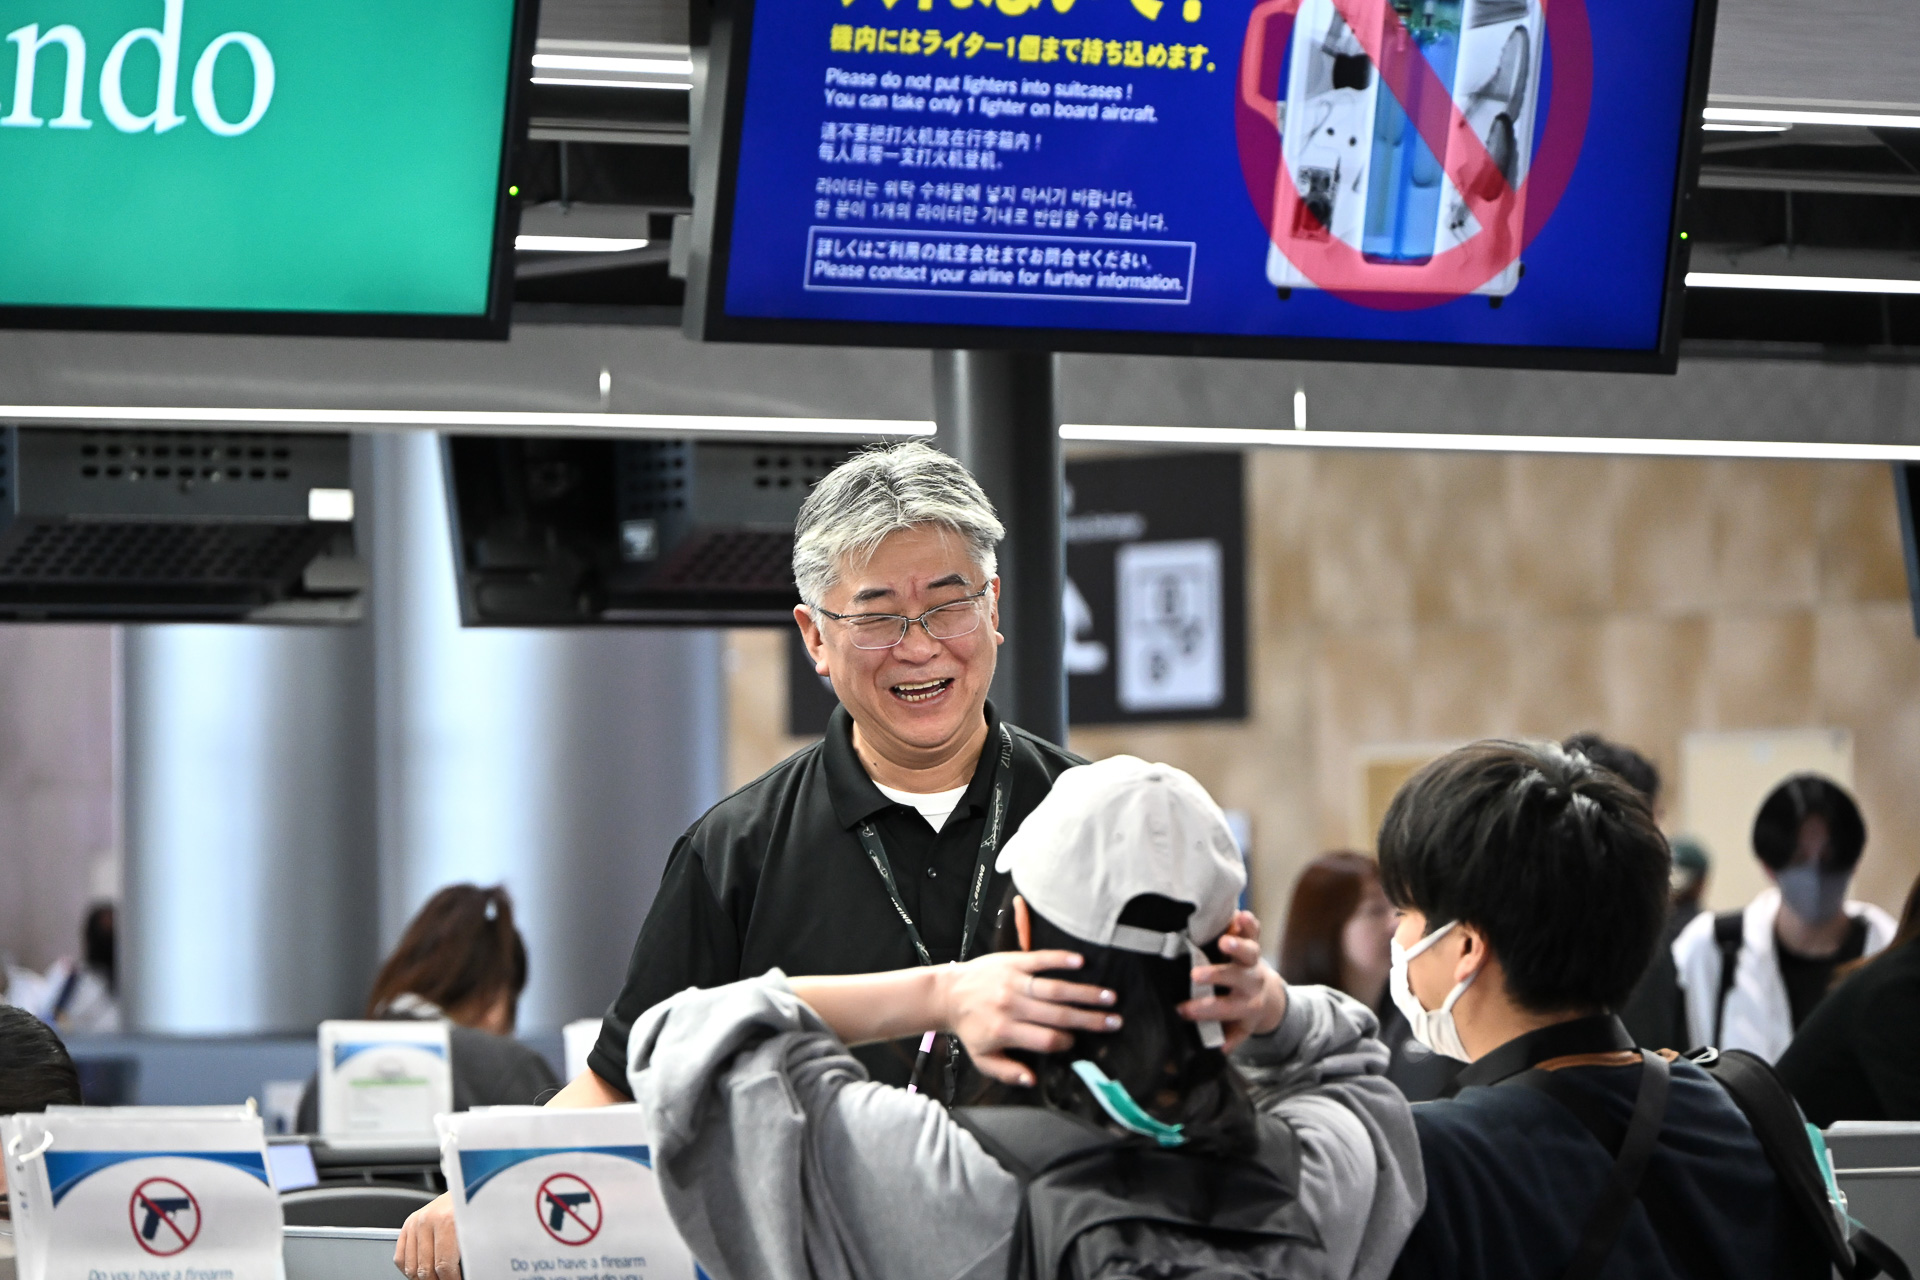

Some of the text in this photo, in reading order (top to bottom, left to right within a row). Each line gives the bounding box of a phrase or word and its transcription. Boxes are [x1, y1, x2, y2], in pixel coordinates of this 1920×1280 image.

[0, 0, 275, 136] ndo
[825, 67, 877, 87] Please
[880, 70, 902, 89] do
[904, 74, 932, 91] not
[934, 75, 960, 93] put
[963, 75, 1018, 95] lighters
[1020, 78, 1051, 97] into
[824, 88, 1158, 122] You can take only 1 lighter on board aircraft.
[815, 177, 1137, 209] 라이터는 위탁 수하물에 넣지 마시기 바랍니다.
[815, 198, 830, 219] 한
[915, 203, 978, 225] 라이터만
[982, 205, 1028, 226] 기내로
[1084, 210, 1099, 230] 수
[1103, 210, 1169, 232] 있습니다.
[813, 259, 1184, 292] Please contact your airline for further information.
[974, 863, 986, 900] BOEING
[891, 896, 913, 925] EING
[510, 1255, 647, 1273] Do you have a firearm
